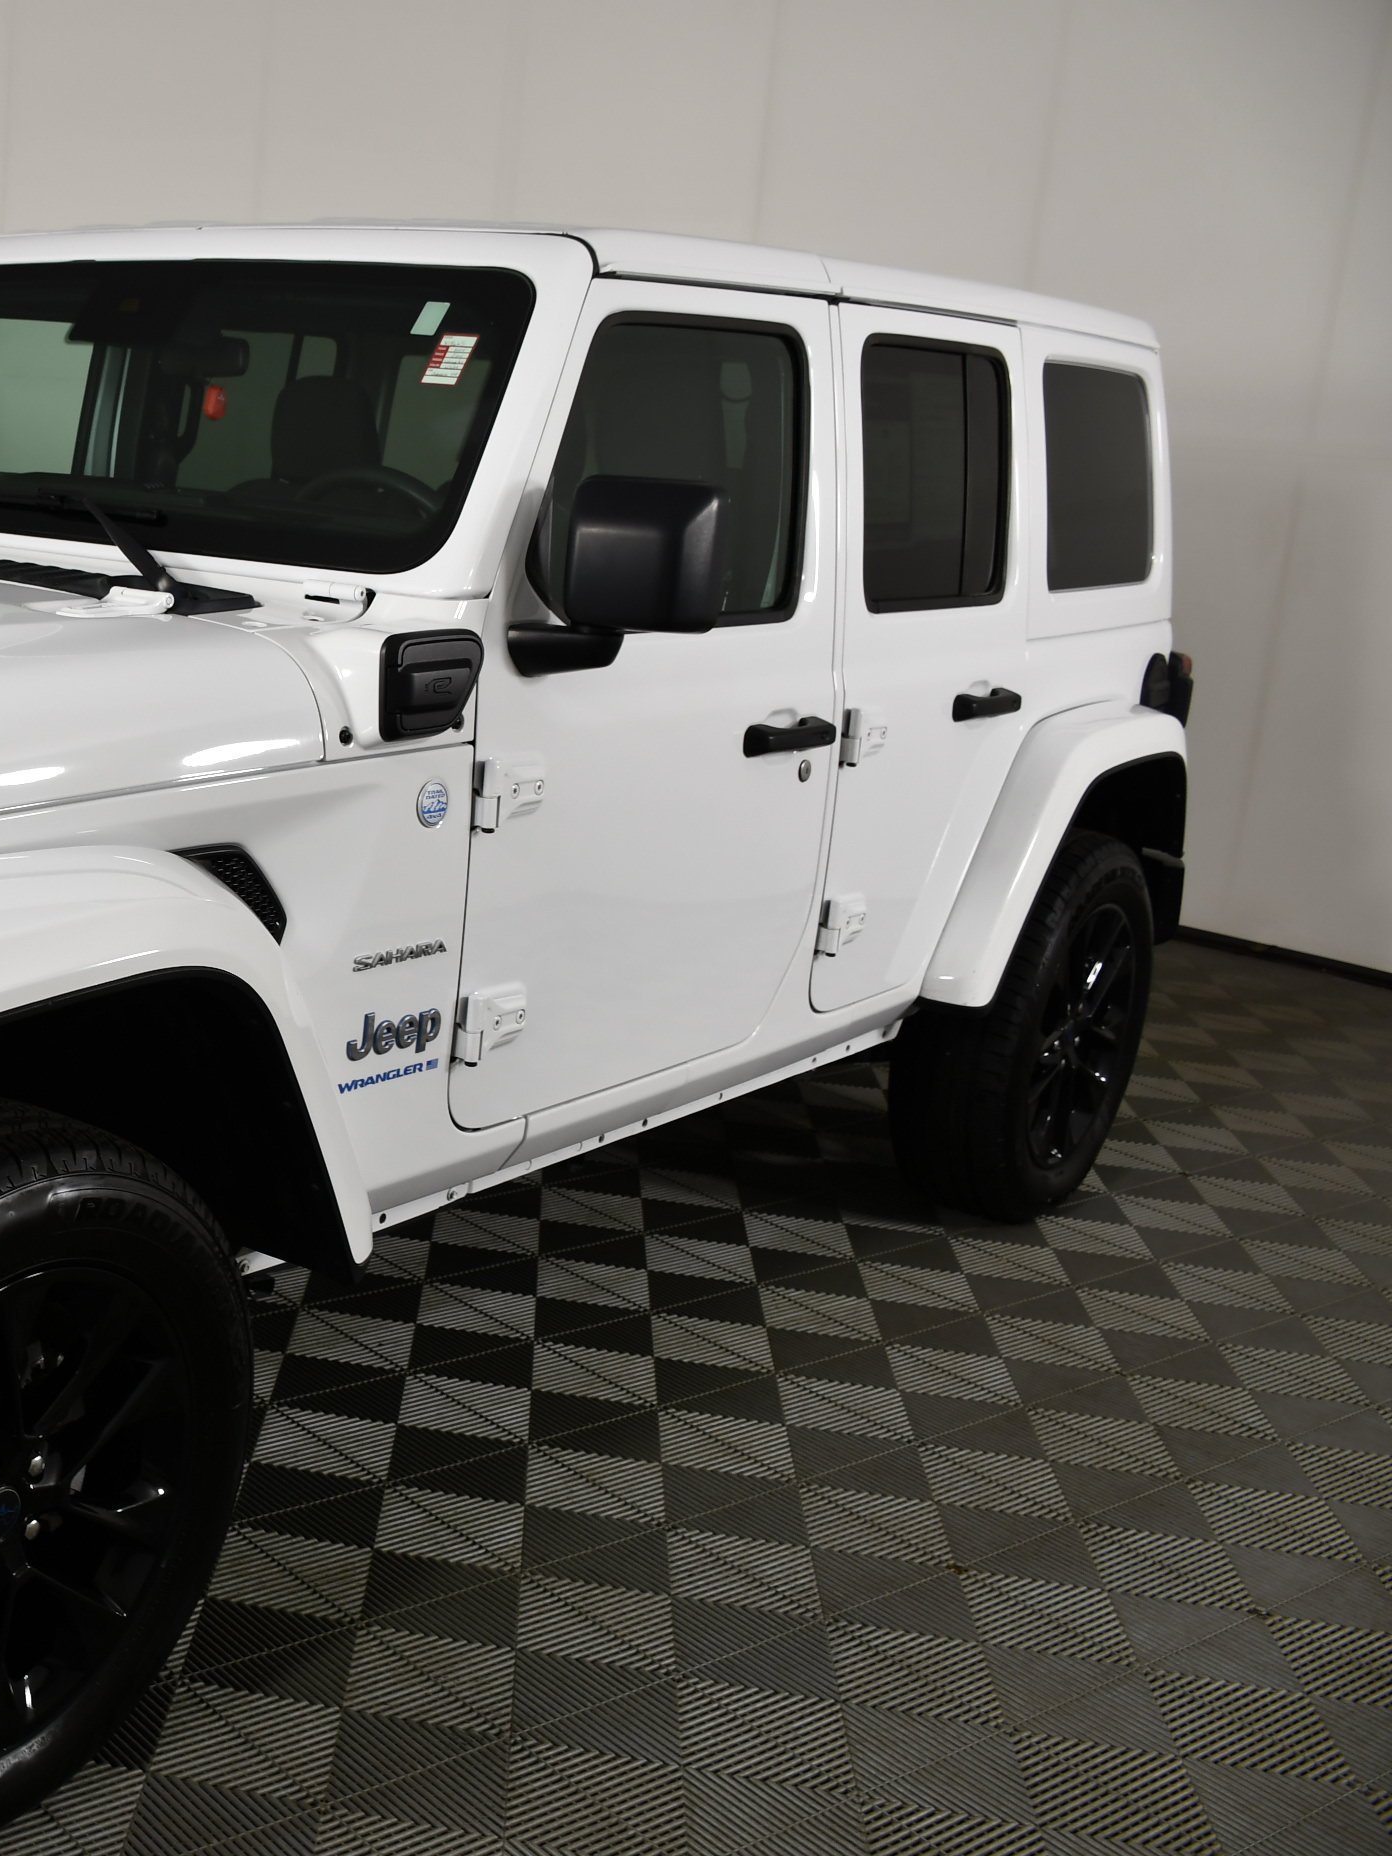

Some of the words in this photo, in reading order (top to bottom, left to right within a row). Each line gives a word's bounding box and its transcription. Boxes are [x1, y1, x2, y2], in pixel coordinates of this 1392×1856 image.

[352, 938, 448, 973] SAHARA
[346, 1007, 442, 1062] Jeep
[337, 1062, 424, 1094] WRANGLER
